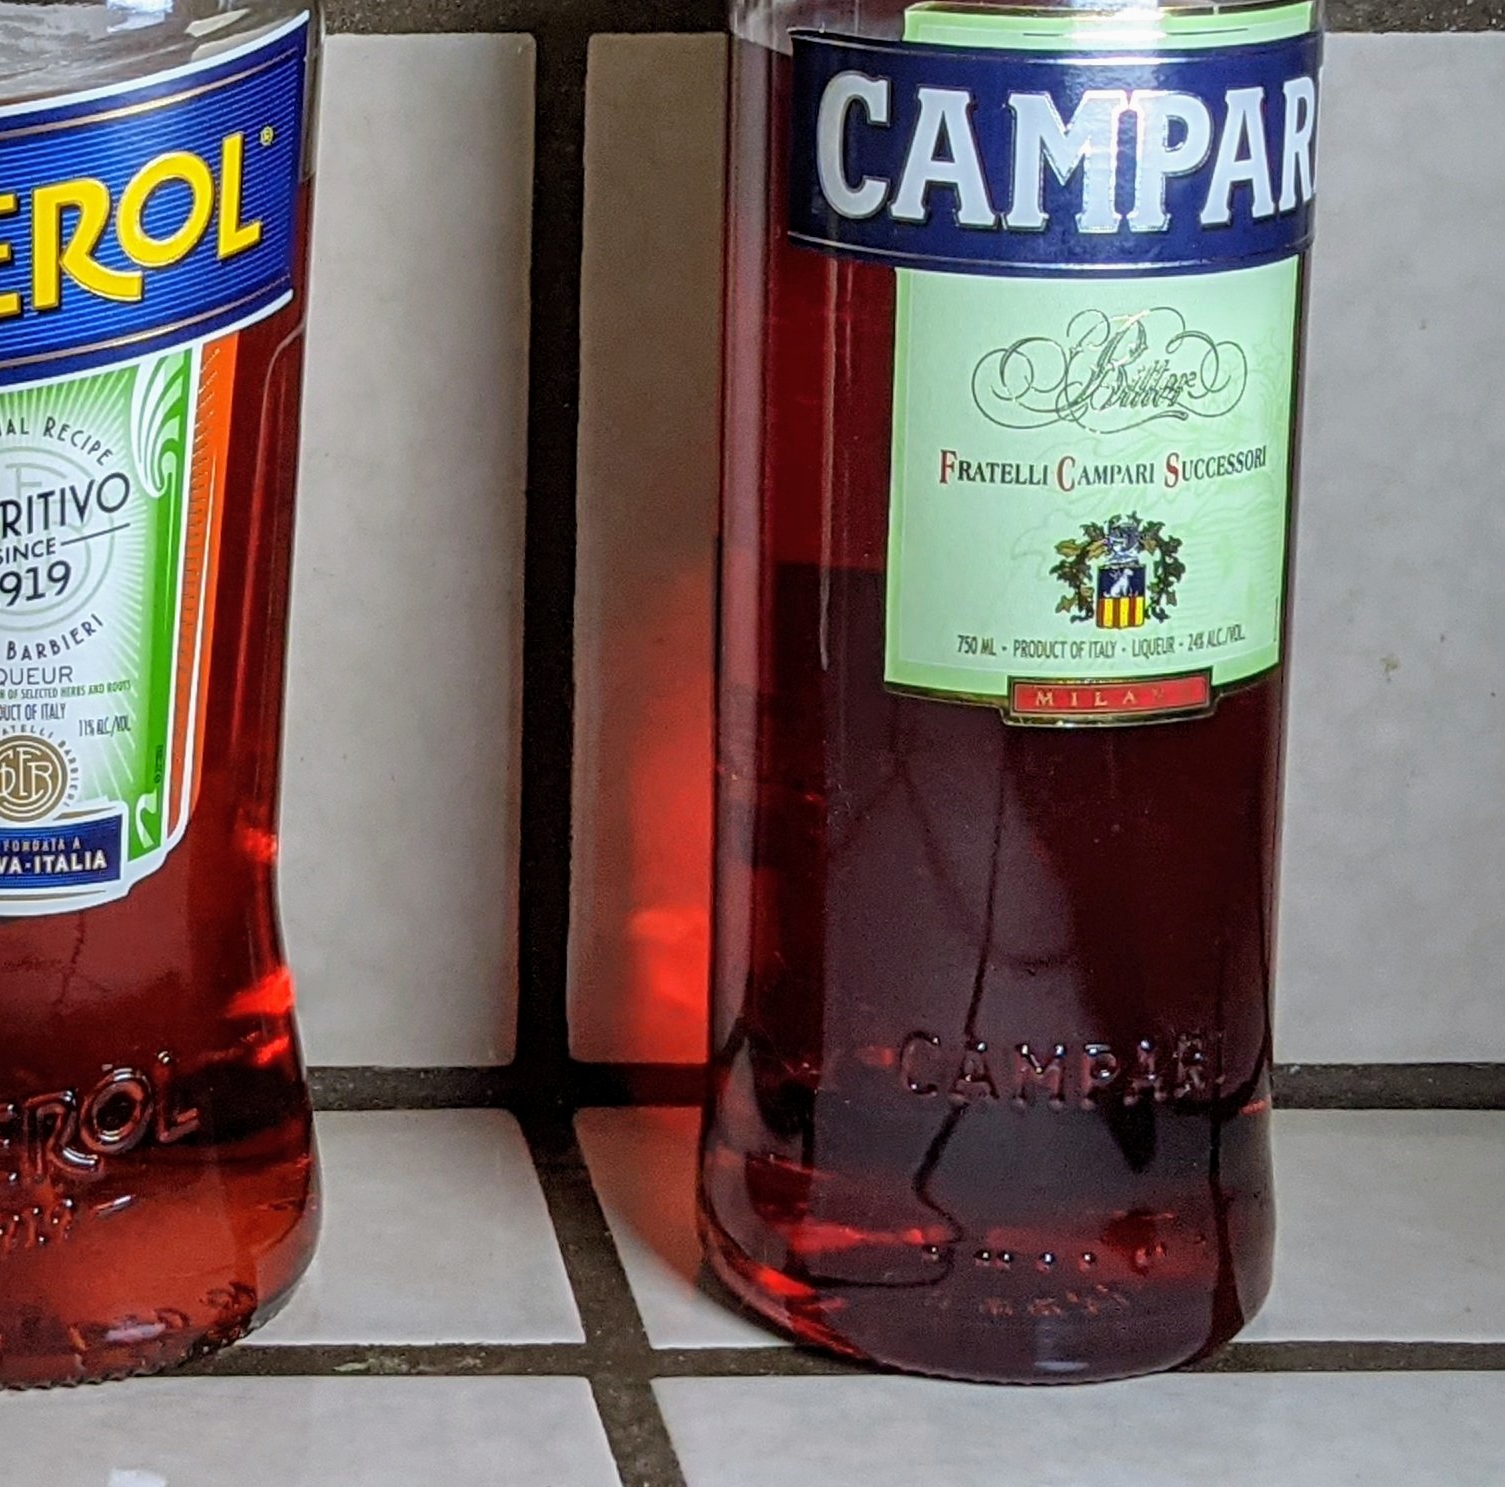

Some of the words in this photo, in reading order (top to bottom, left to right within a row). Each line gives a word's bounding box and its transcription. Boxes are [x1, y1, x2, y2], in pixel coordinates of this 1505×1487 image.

[43, 416, 114, 466] RECIPE
[939, 449, 1048, 487] FRATELLI
[1056, 455, 1155, 492] CAMPARI
[1163, 444, 1267, 489] SUCCESSORI
[6, 613, 104, 661] BARBIERI
[957, 634, 978, 655] 750
[1013, 638, 1068, 659] PRODUCT
[1070, 640, 1086, 659] OF
[1089, 640, 1117, 660] ITALY
[1131, 635, 1176, 658] LIQUEUR
[21, 687, 58, 699] SELECTED
[25, 703, 37, 721] OF
[41, 703, 66, 720] ITALY
[72, 836, 81, 849] A
